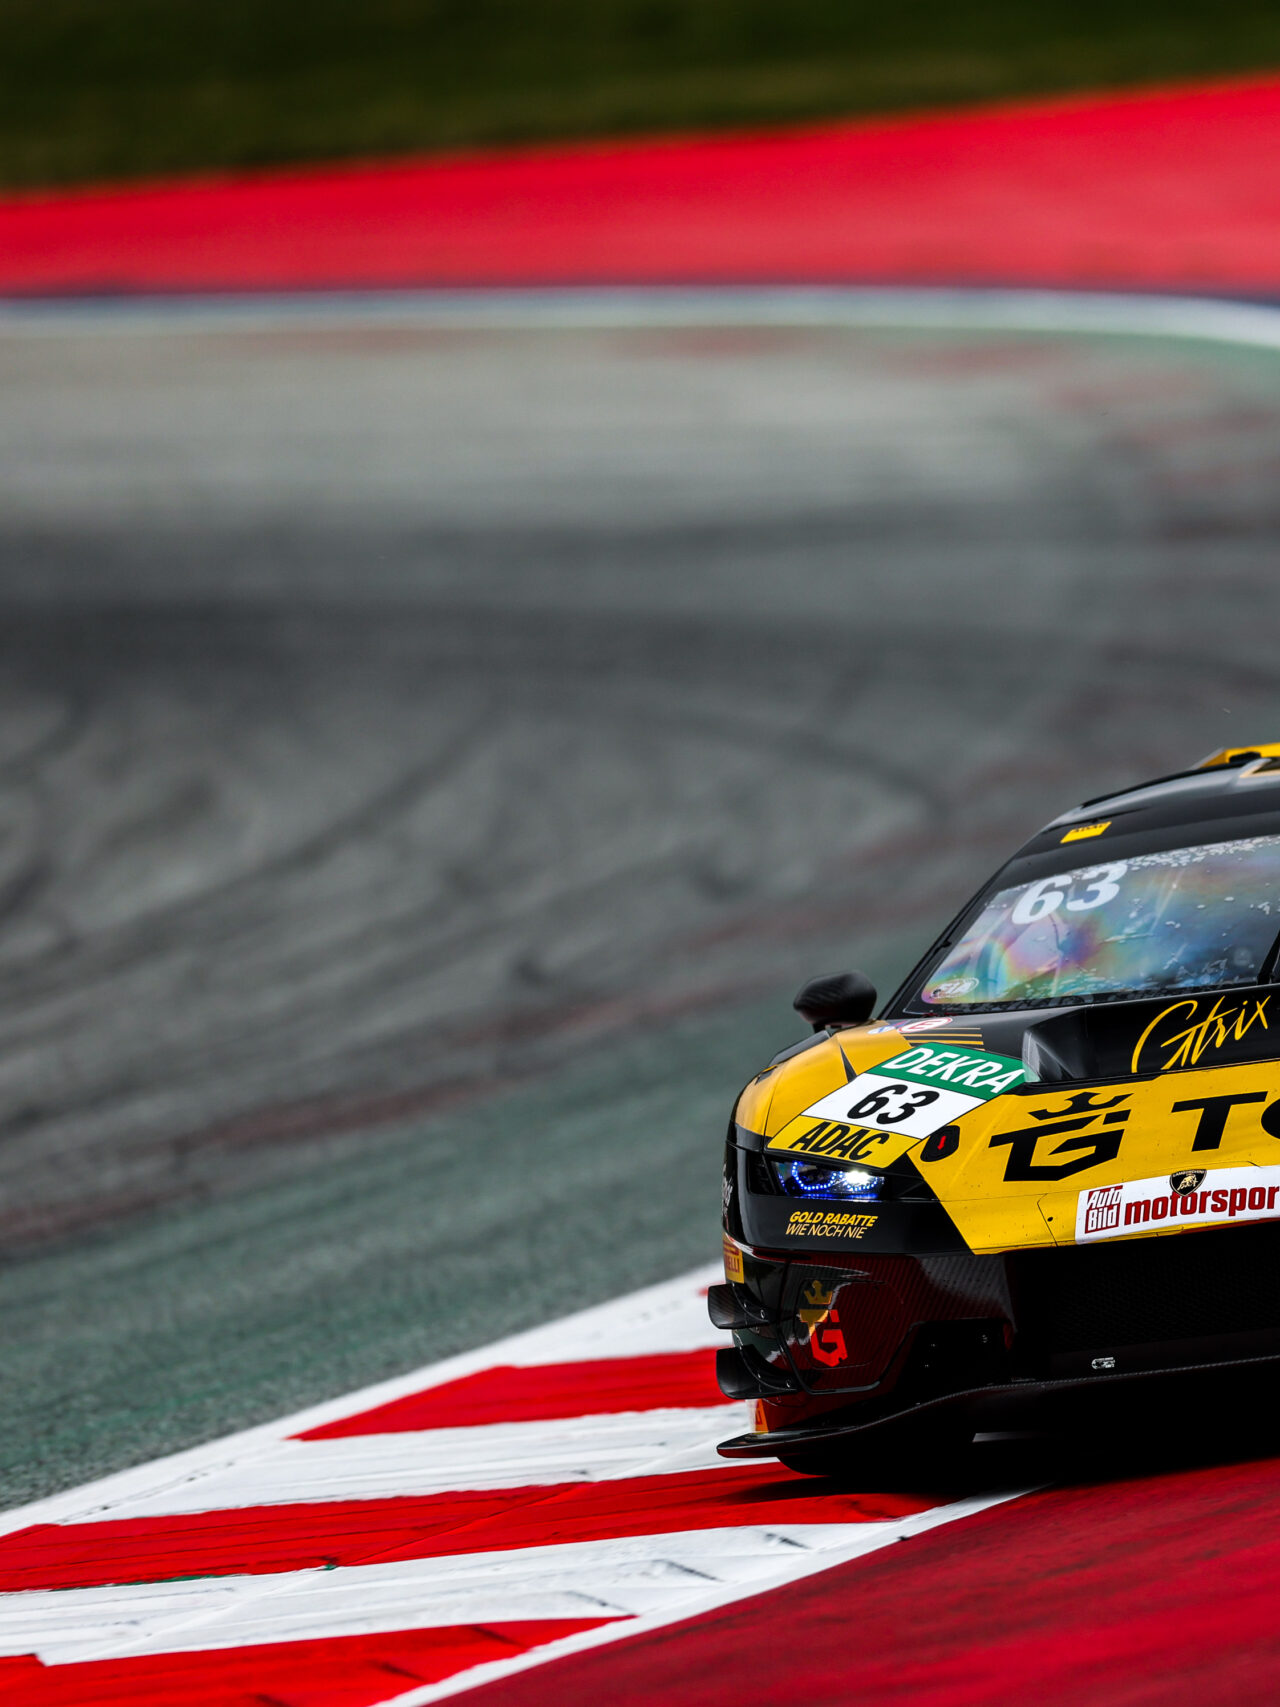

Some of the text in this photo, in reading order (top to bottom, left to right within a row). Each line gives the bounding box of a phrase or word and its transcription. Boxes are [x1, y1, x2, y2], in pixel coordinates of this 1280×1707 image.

[1012, 863, 1128, 924] 63
[882, 1047, 1026, 1093] DEKRA
[847, 1084, 940, 1125] 63
[789, 1121, 889, 1160] ADAC
[1087, 1187, 1122, 1209] Auto
[786, 1223, 867, 1238] WIE NOCH NIE
[789, 1211, 878, 1227] GOLD RABATTE
[1087, 1206, 1120, 1231] Bild
